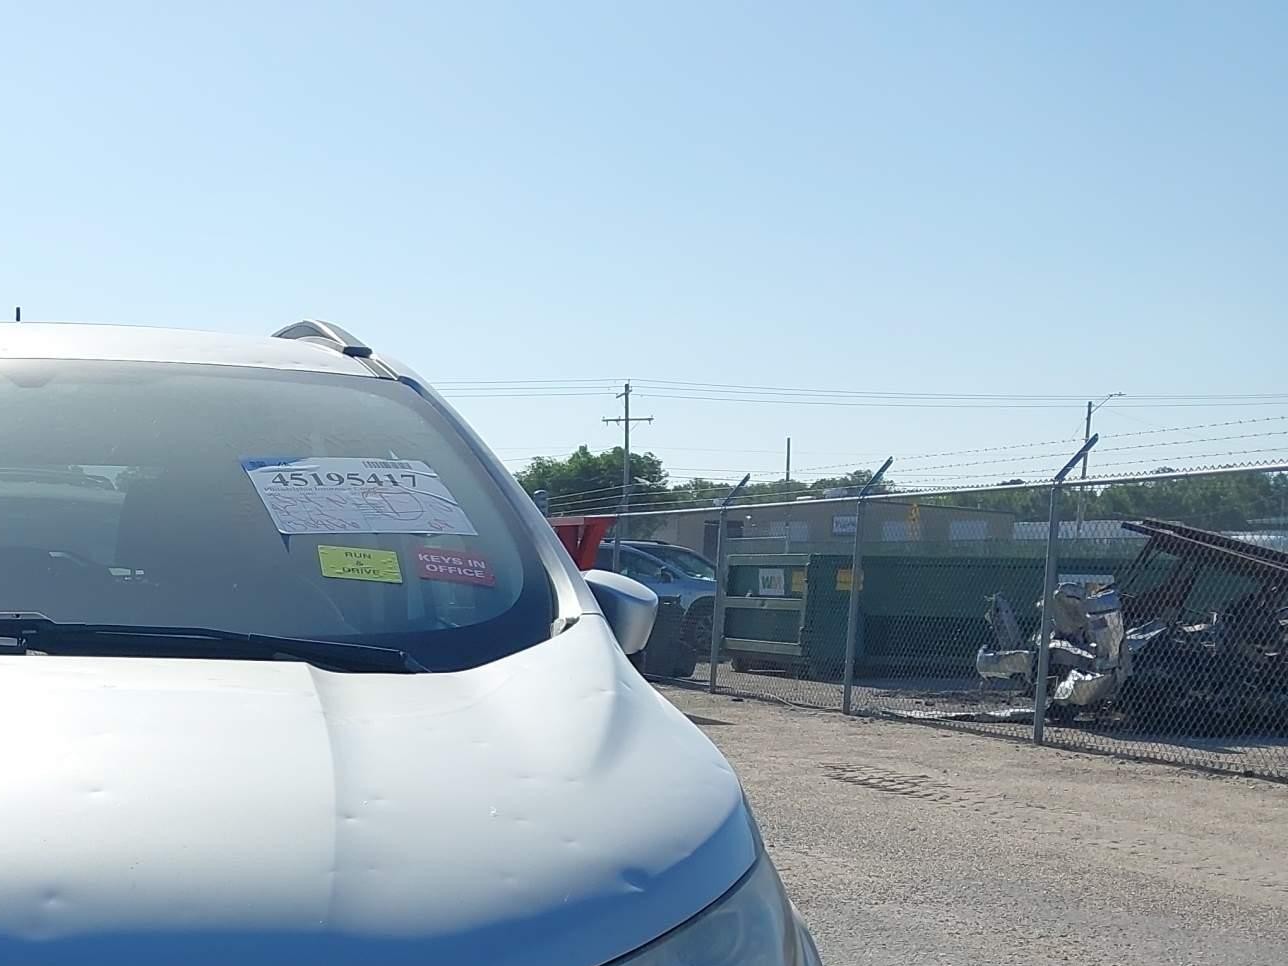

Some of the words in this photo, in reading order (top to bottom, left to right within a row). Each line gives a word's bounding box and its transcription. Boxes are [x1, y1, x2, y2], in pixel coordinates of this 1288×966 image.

[271, 472, 416, 488] 45195417
[344, 551, 372, 560] RUN
[418, 553, 463, 566] KEYS
[468, 559, 486, 569] IN
[342, 566, 380, 575] DRIVE
[425, 563, 486, 578] OFFICE
